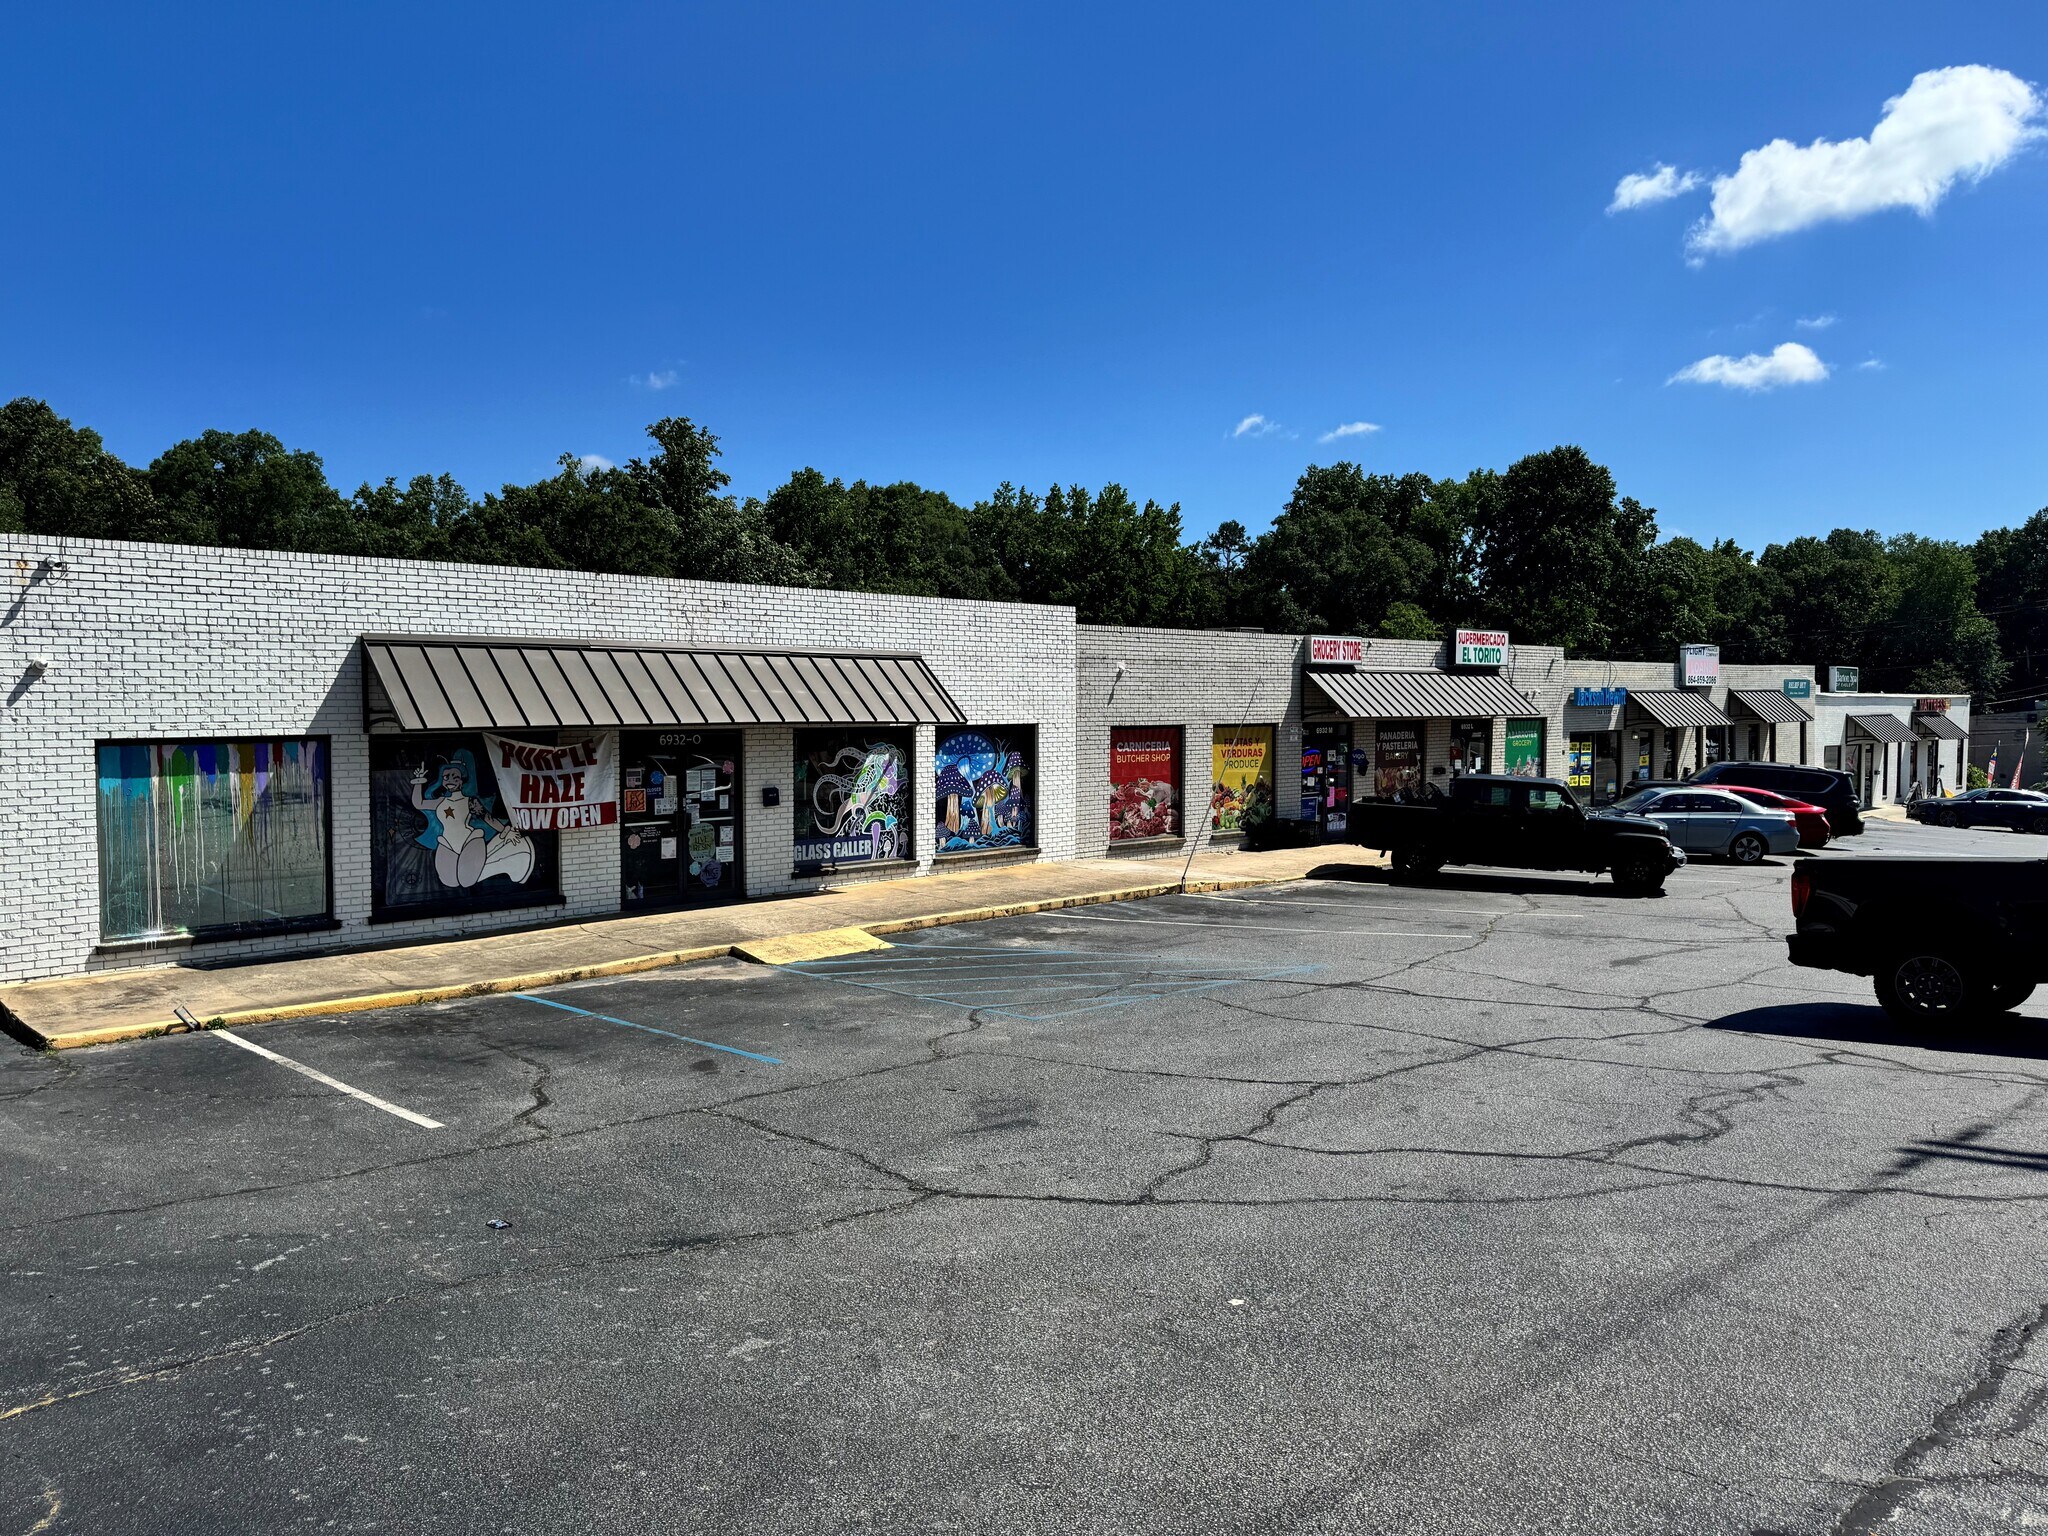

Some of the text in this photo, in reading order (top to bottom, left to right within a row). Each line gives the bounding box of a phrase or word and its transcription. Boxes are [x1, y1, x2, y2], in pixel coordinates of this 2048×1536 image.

[1458, 632, 1506, 647] SUPERMERCADO
[1313, 639, 1361, 660] GROCERY STORE
[1462, 646, 1502, 664] EL TORITO
[1687, 646, 1706, 656] FLIGHT
[1255, 736, 1260, 746] Y
[1380, 731, 1415, 740] PANADERIA
[1117, 741, 1171, 752] CARNICERIA
[1376, 741, 1418, 751] Y PASTELERIA
[499, 738, 598, 772] PURPLE
[1117, 753, 1171, 763] BUTCHER SHOP
[520, 771, 585, 804] HAZE
[557, 803, 602, 829] OPEN
[793, 839, 872, 861] GLASS GALLER
